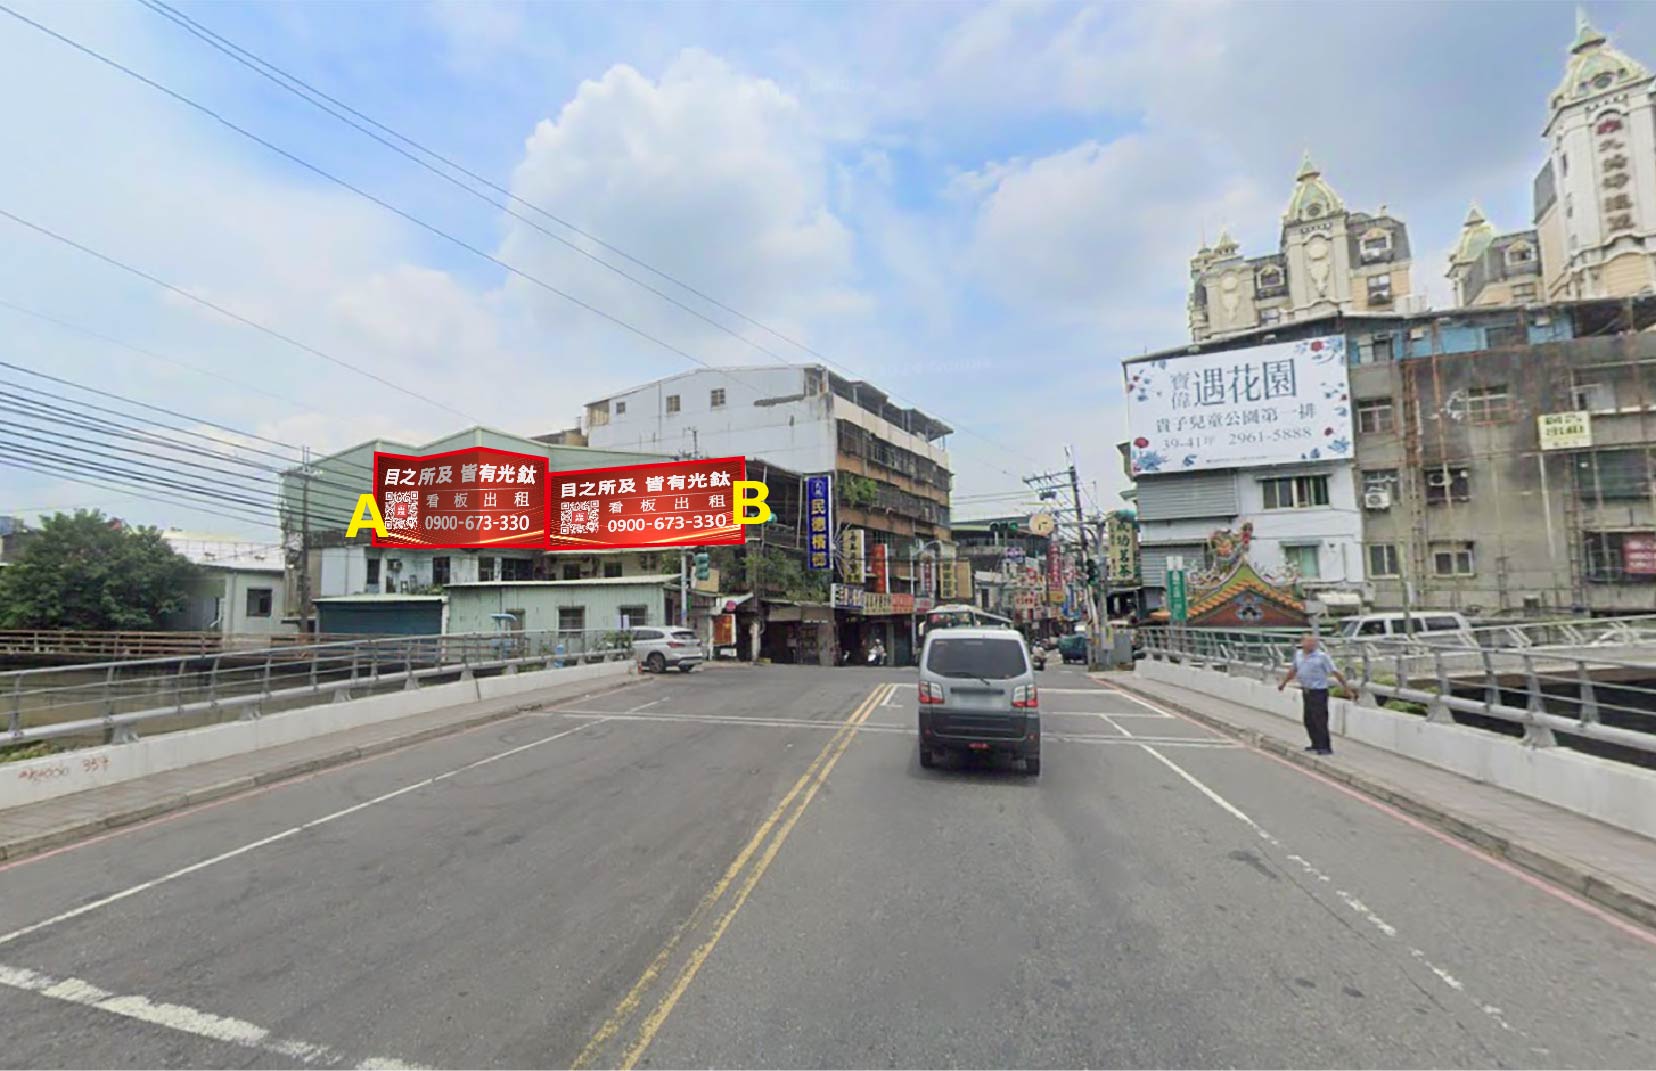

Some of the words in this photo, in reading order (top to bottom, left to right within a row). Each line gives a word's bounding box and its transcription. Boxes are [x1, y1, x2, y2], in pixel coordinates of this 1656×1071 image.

[1193, 359, 1297, 406] 遇花園
[385, 465, 453, 486] 目之所及
[460, 464, 537, 485] 皆有光鈦
[560, 478, 636, 498] 目之所及
[645, 470, 731, 493] 皆有光鈦
[426, 491, 530, 509] 看板出租
[608, 494, 726, 514] 看板出租
[424, 515, 530, 531] 0900-673-330
[607, 514, 727, 533] 0900-673-330
